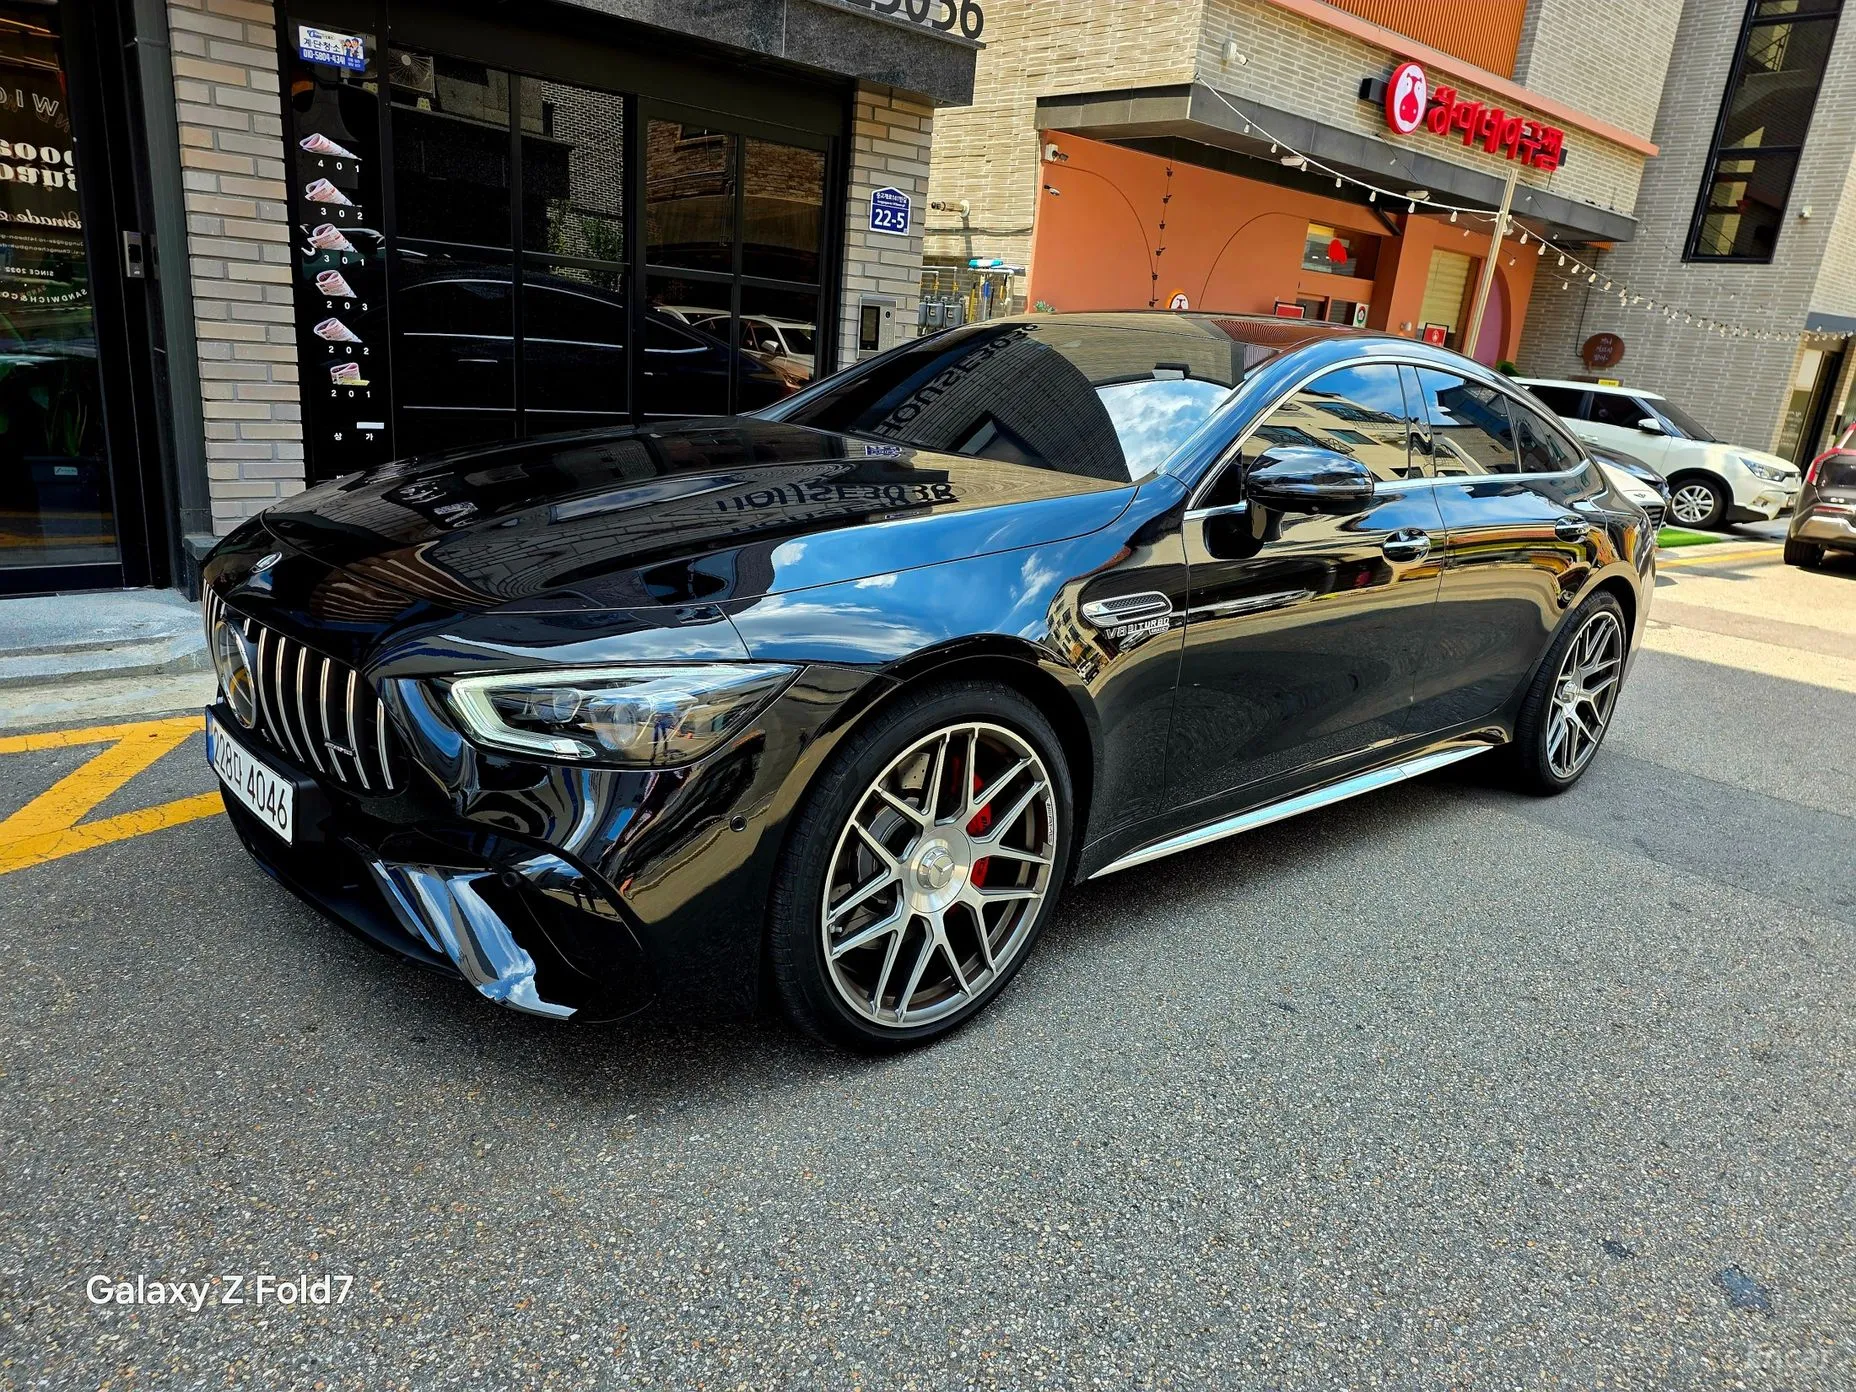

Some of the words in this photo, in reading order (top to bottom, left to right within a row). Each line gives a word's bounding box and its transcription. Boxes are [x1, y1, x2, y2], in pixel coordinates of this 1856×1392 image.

[318, 160, 360, 173] 401
[321, 207, 363, 220] 302
[874, 208, 905, 229] 22-5
[324, 255, 365, 266] 301
[326, 301, 368, 311] 203
[328, 346, 369, 355] 202
[331, 390, 370, 398] 201
[1105, 625, 1128, 640] V8
[247, 764, 288, 830] 4046
